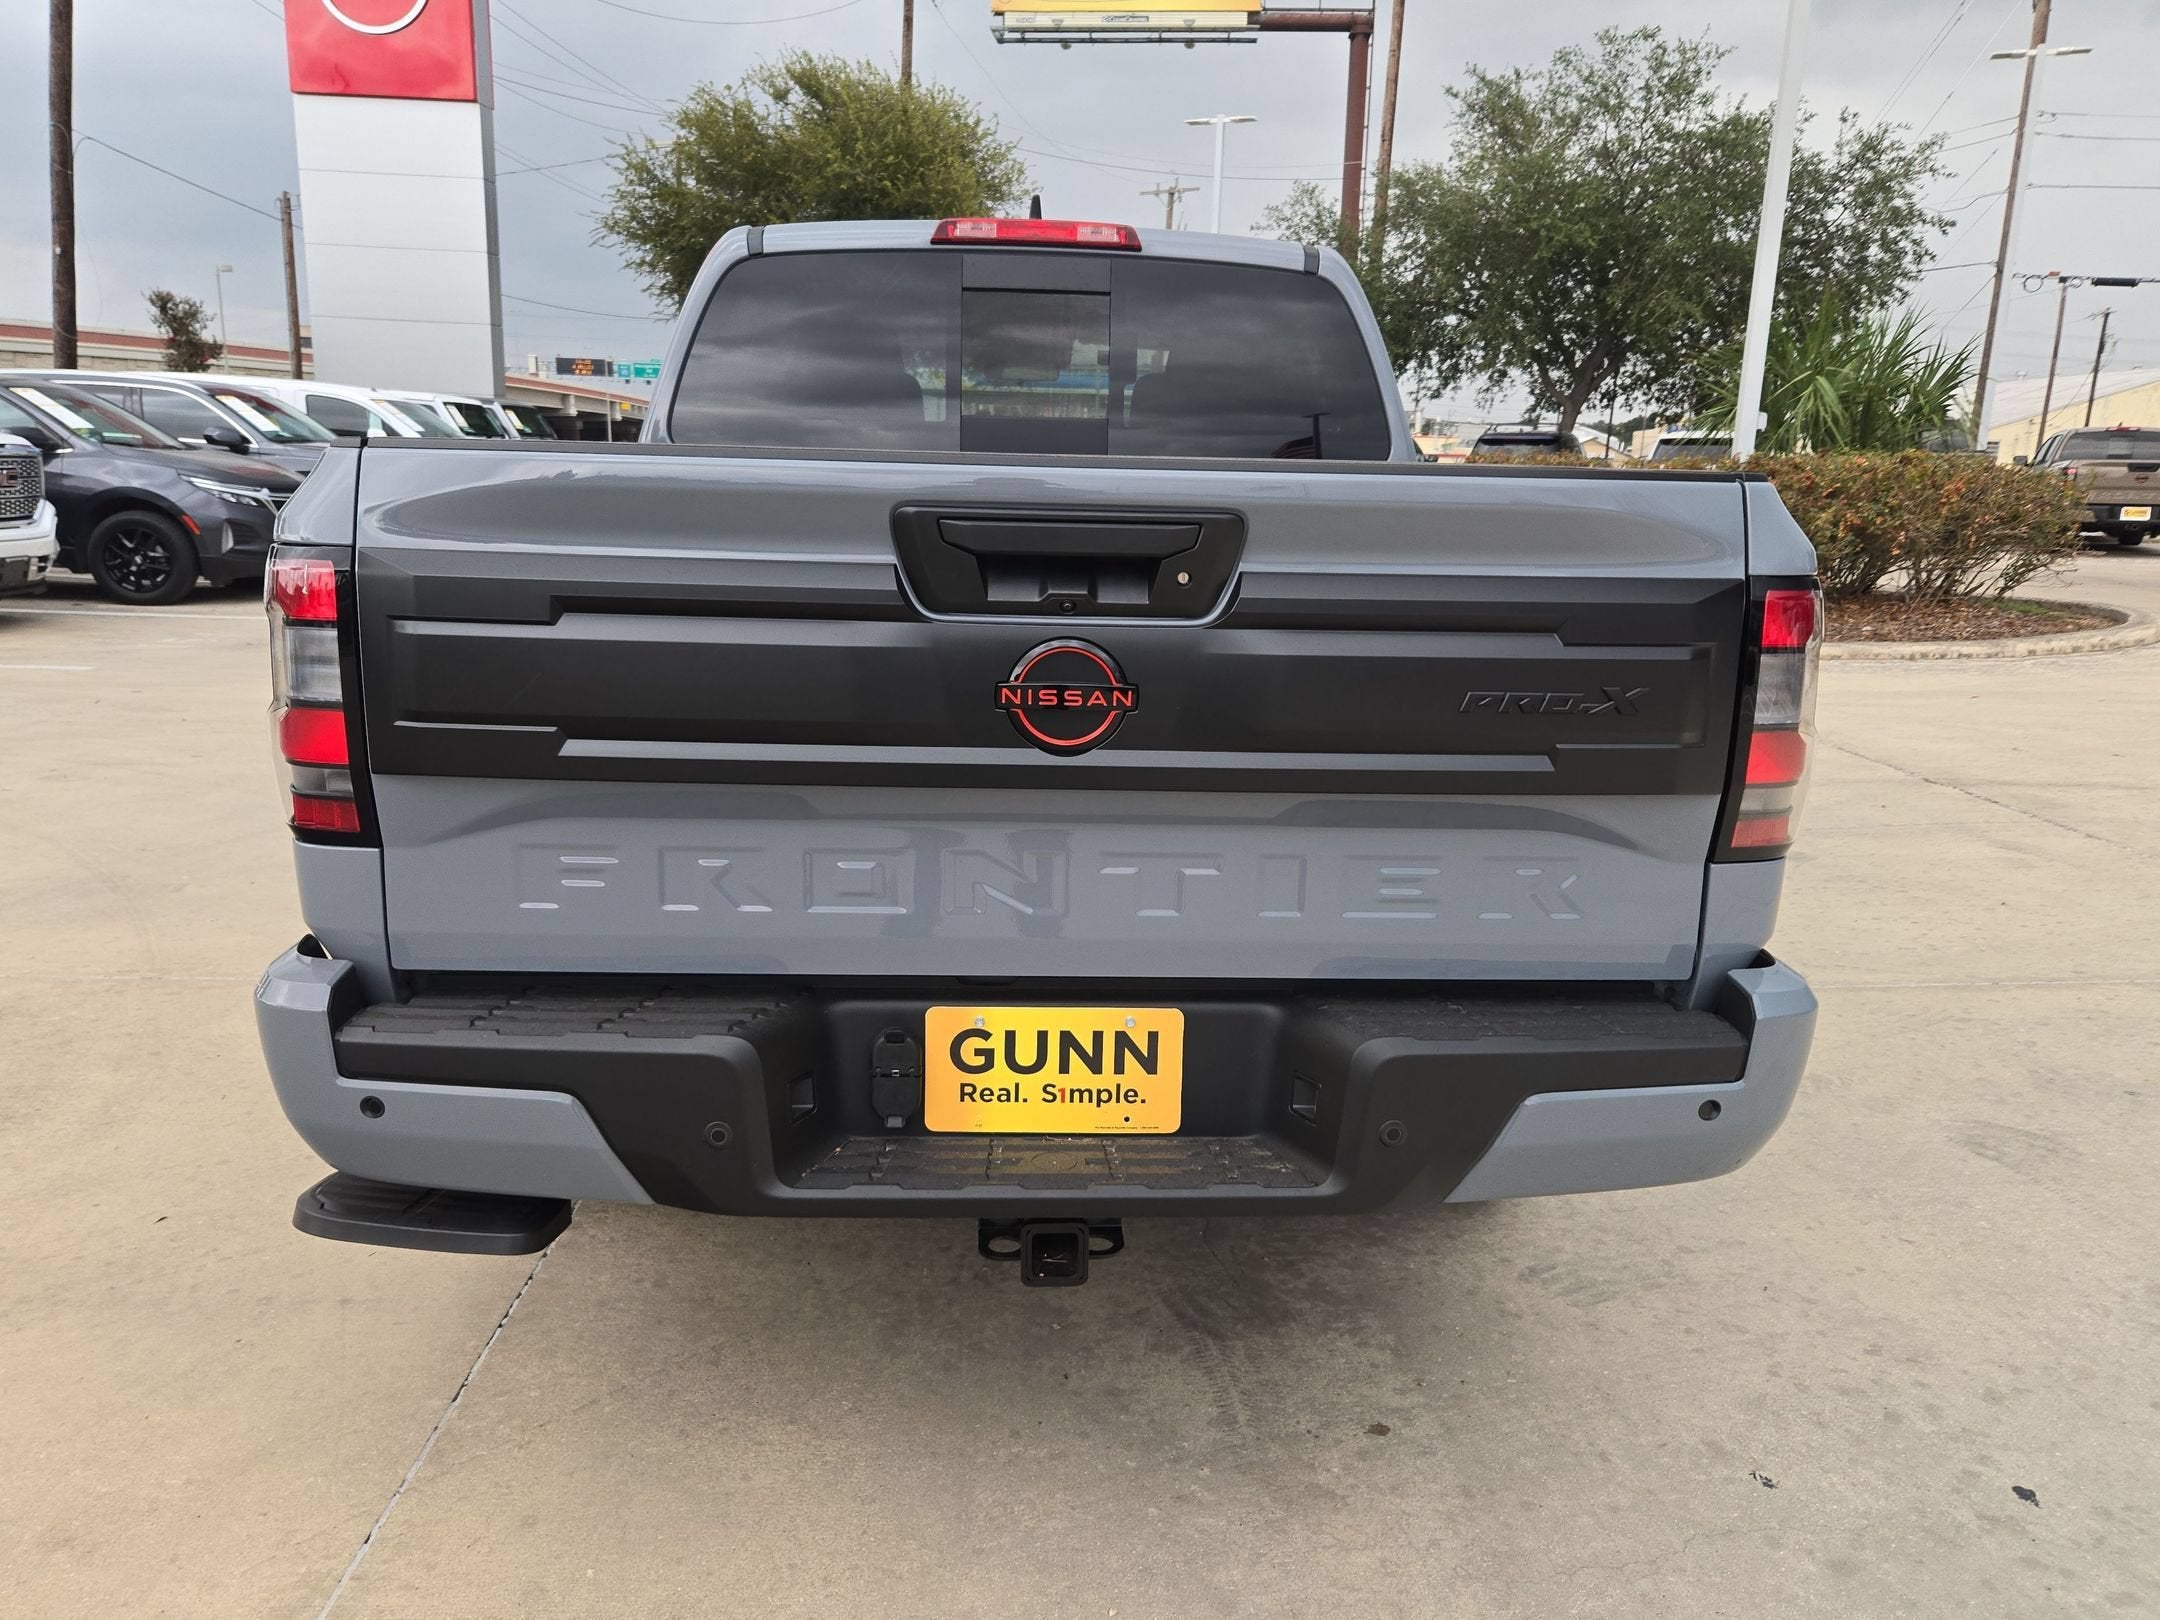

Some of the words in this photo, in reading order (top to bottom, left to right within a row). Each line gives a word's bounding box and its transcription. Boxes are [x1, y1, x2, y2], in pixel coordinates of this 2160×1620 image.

[1001, 687, 1132, 707] NISSAN
[1459, 687, 1650, 715] PRO-X
[516, 843, 1582, 919] FRONTIER
[949, 1028, 1159, 1075] GUNN
[959, 1082, 1028, 1103] Real.
[1041, 1083, 1147, 1108] S1mple.
